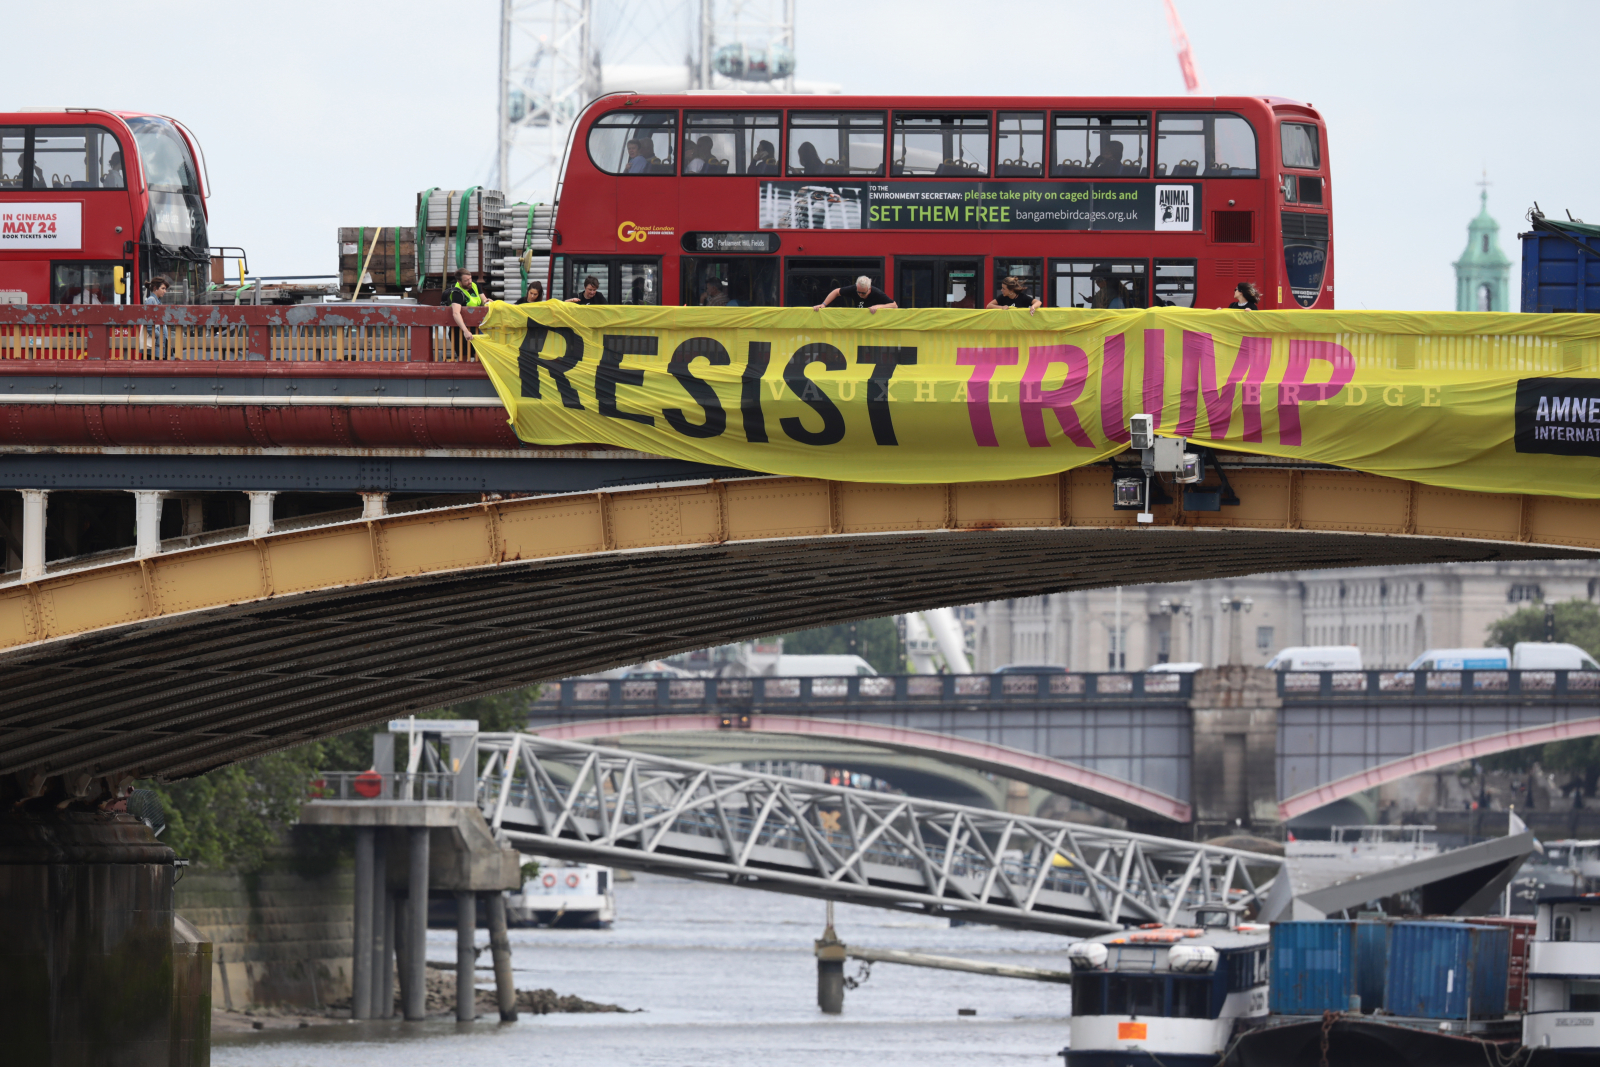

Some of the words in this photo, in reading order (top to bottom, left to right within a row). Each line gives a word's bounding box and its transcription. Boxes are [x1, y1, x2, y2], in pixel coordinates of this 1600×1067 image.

[869, 192, 919, 200] ENVIRONMENT
[921, 192, 963, 200] SECRETARY:
[965, 190, 997, 201] please
[1000, 190, 1021, 200] take
[1022, 190, 1042, 202] pity
[1044, 192, 1057, 200] on
[1060, 190, 1089, 202] caged
[1092, 190, 1117, 200] birds
[1119, 190, 1138, 200] and
[1159, 190, 1189, 205] ANIMAL
[2, 213, 13, 221] IN
[16, 213, 57, 221] CINEMAS
[869, 205, 902, 222] SET
[906, 205, 959, 222] THEM
[965, 206, 1010, 222] FREE
[1016, 209, 1138, 222] bangamebirdcages.org.uk
[1175, 206, 1190, 223] AID
[2, 222, 35, 233] MAY
[38, 222, 57, 233] 24
[617, 221, 647, 242] Go
[701, 237, 714, 248] 88
[717, 239, 741, 247] Parliament
[751, 239, 765, 247] Fields
[518, 317, 918, 446] RESIST
[955, 328, 1356, 449] TRUMP
[765, 380, 1043, 402] VAUXHALL
[1243, 383, 1441, 407] BRIDGE
